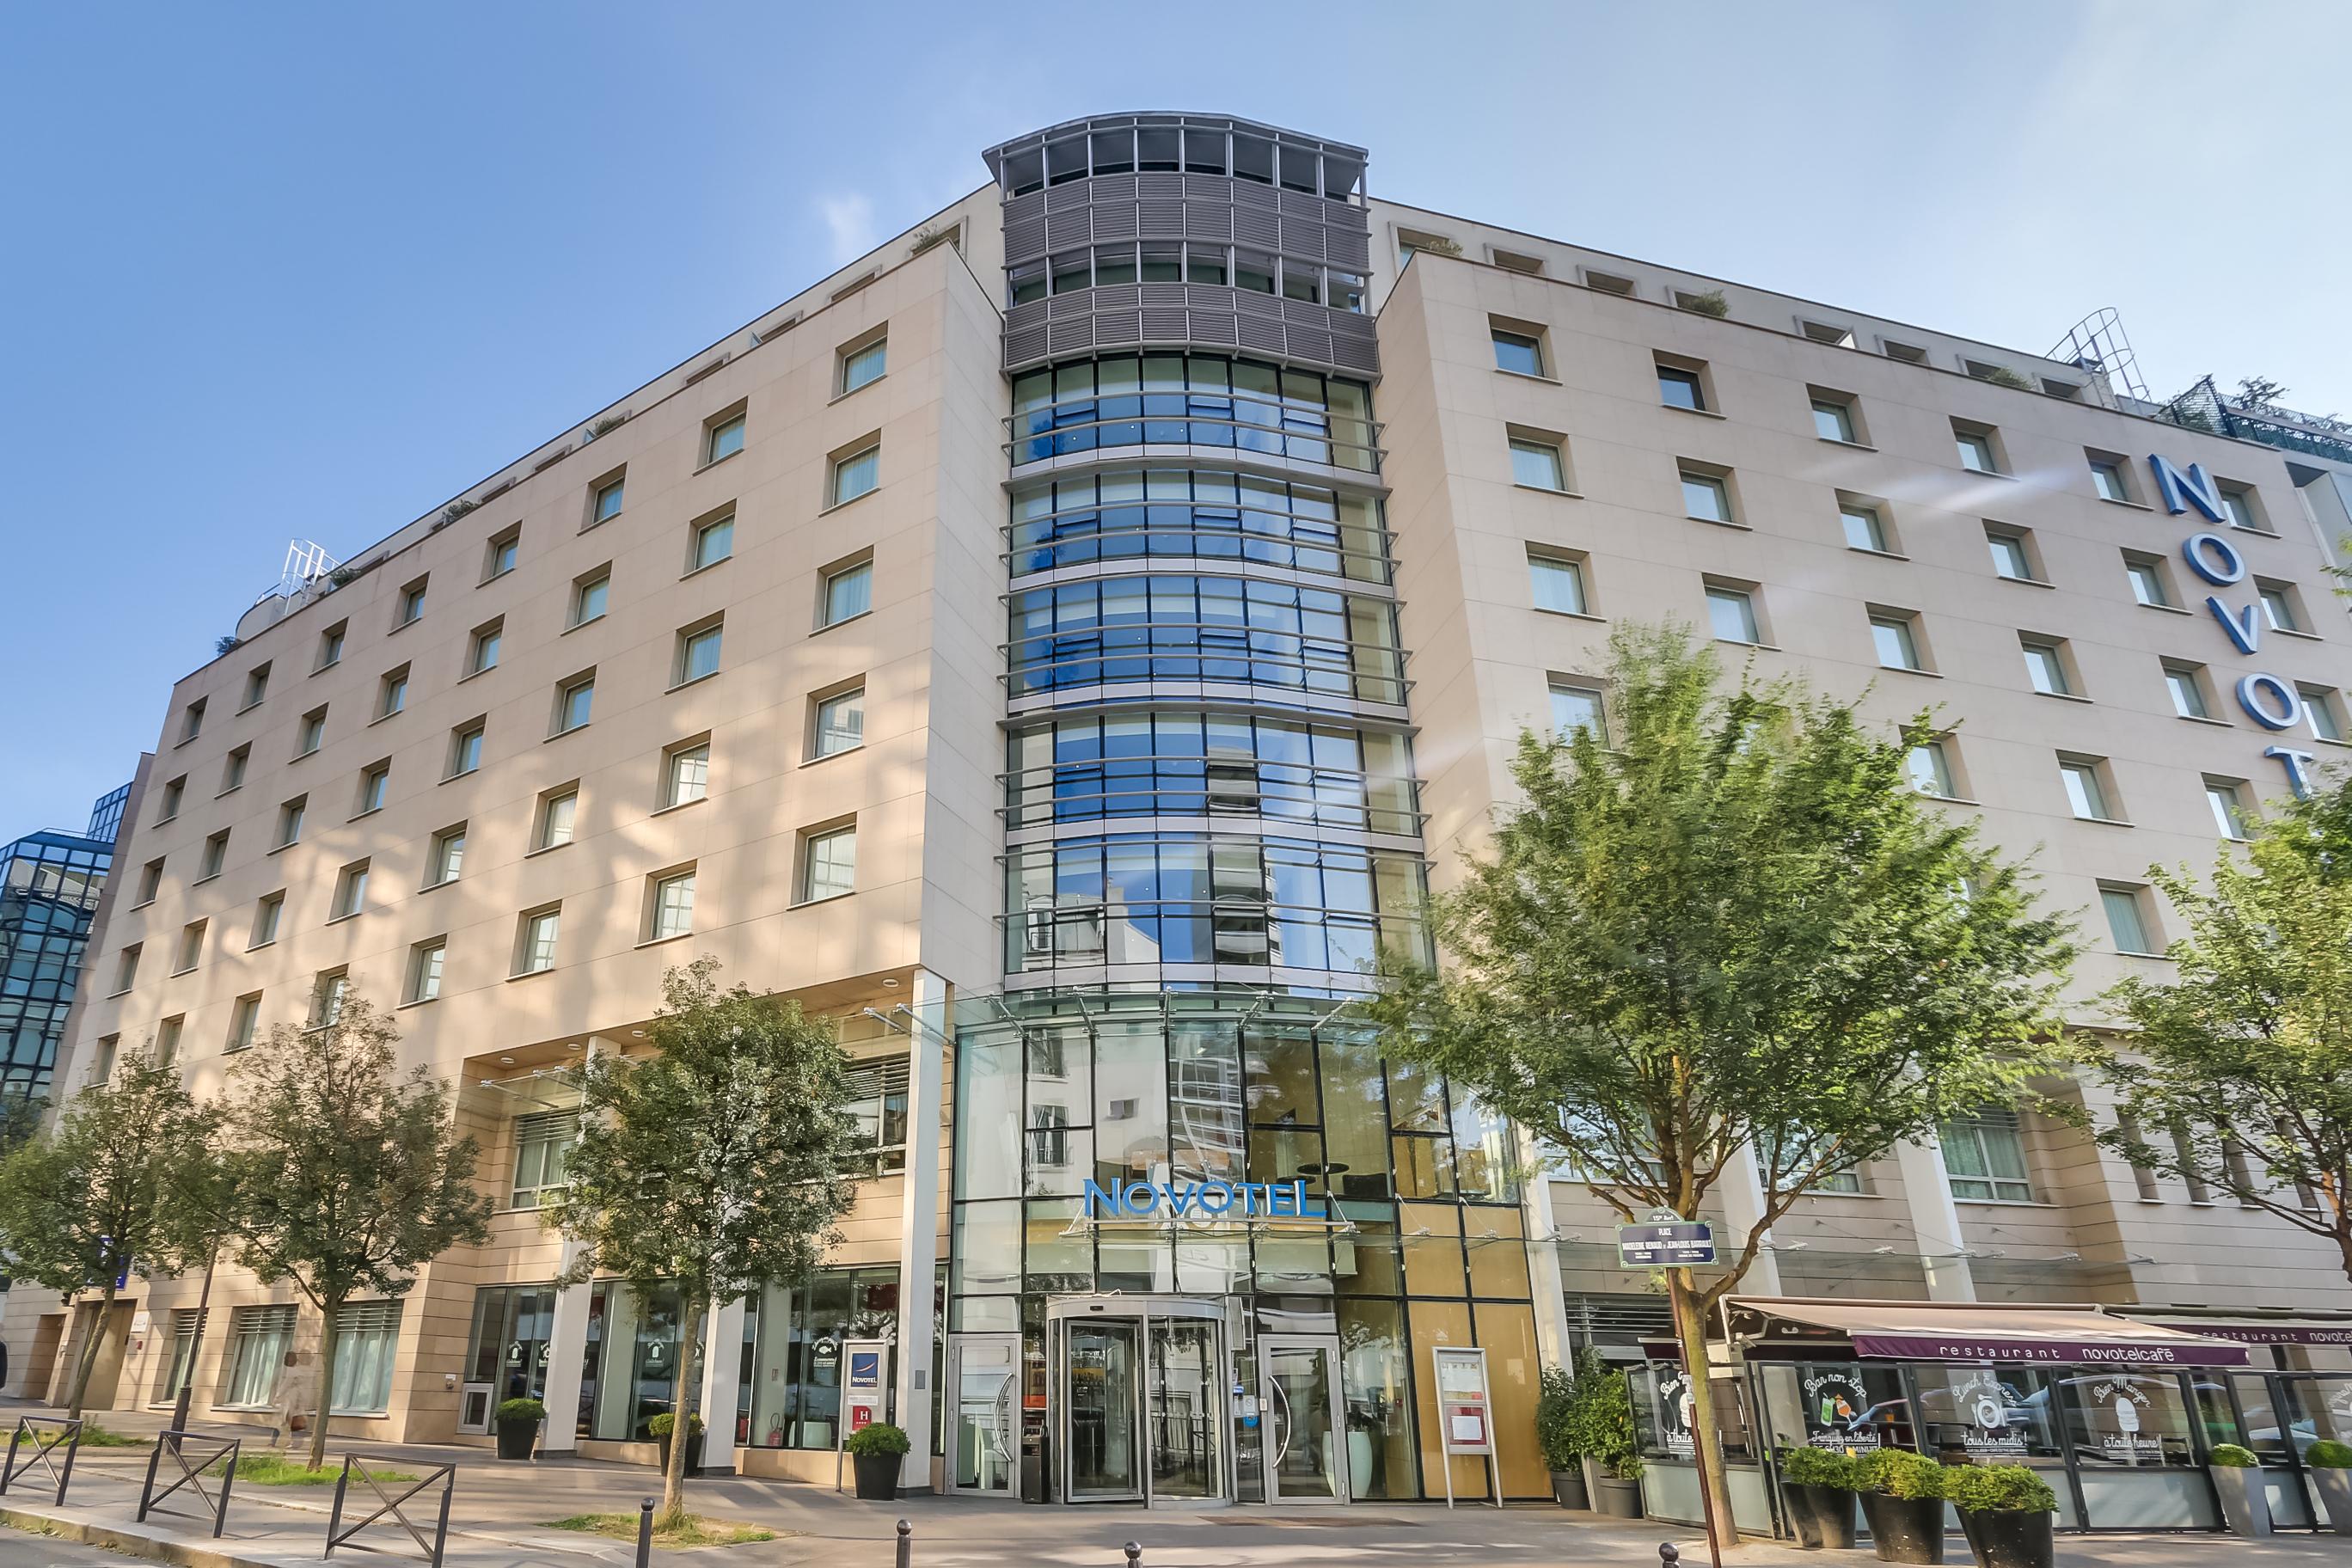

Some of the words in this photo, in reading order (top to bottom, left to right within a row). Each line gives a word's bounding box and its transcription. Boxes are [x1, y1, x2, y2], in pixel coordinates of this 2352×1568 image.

[2147, 453, 2314, 802] NOVOT
[1082, 1177, 1327, 1217] NOVOTEL
[1658, 1228, 1672, 1236] PLACE
[1939, 1345, 2060, 1359] restaurant
[1660, 1379, 1680, 1400] Bien
[1804, 1376, 1827, 1397] Bar
[1828, 1374, 1847, 1383] non
[1848, 1377, 1866, 1398] stop
[1952, 1372, 1981, 1403] Lunch
[2093, 1384, 2114, 1403] Bien
[2112, 1375, 2151, 1408] Manger
[861, 1411, 868, 1420] H
[1671, 1429, 1694, 1442] toute
[1960, 1430, 1983, 1445] tous
[1984, 1430, 1999, 1445] les
